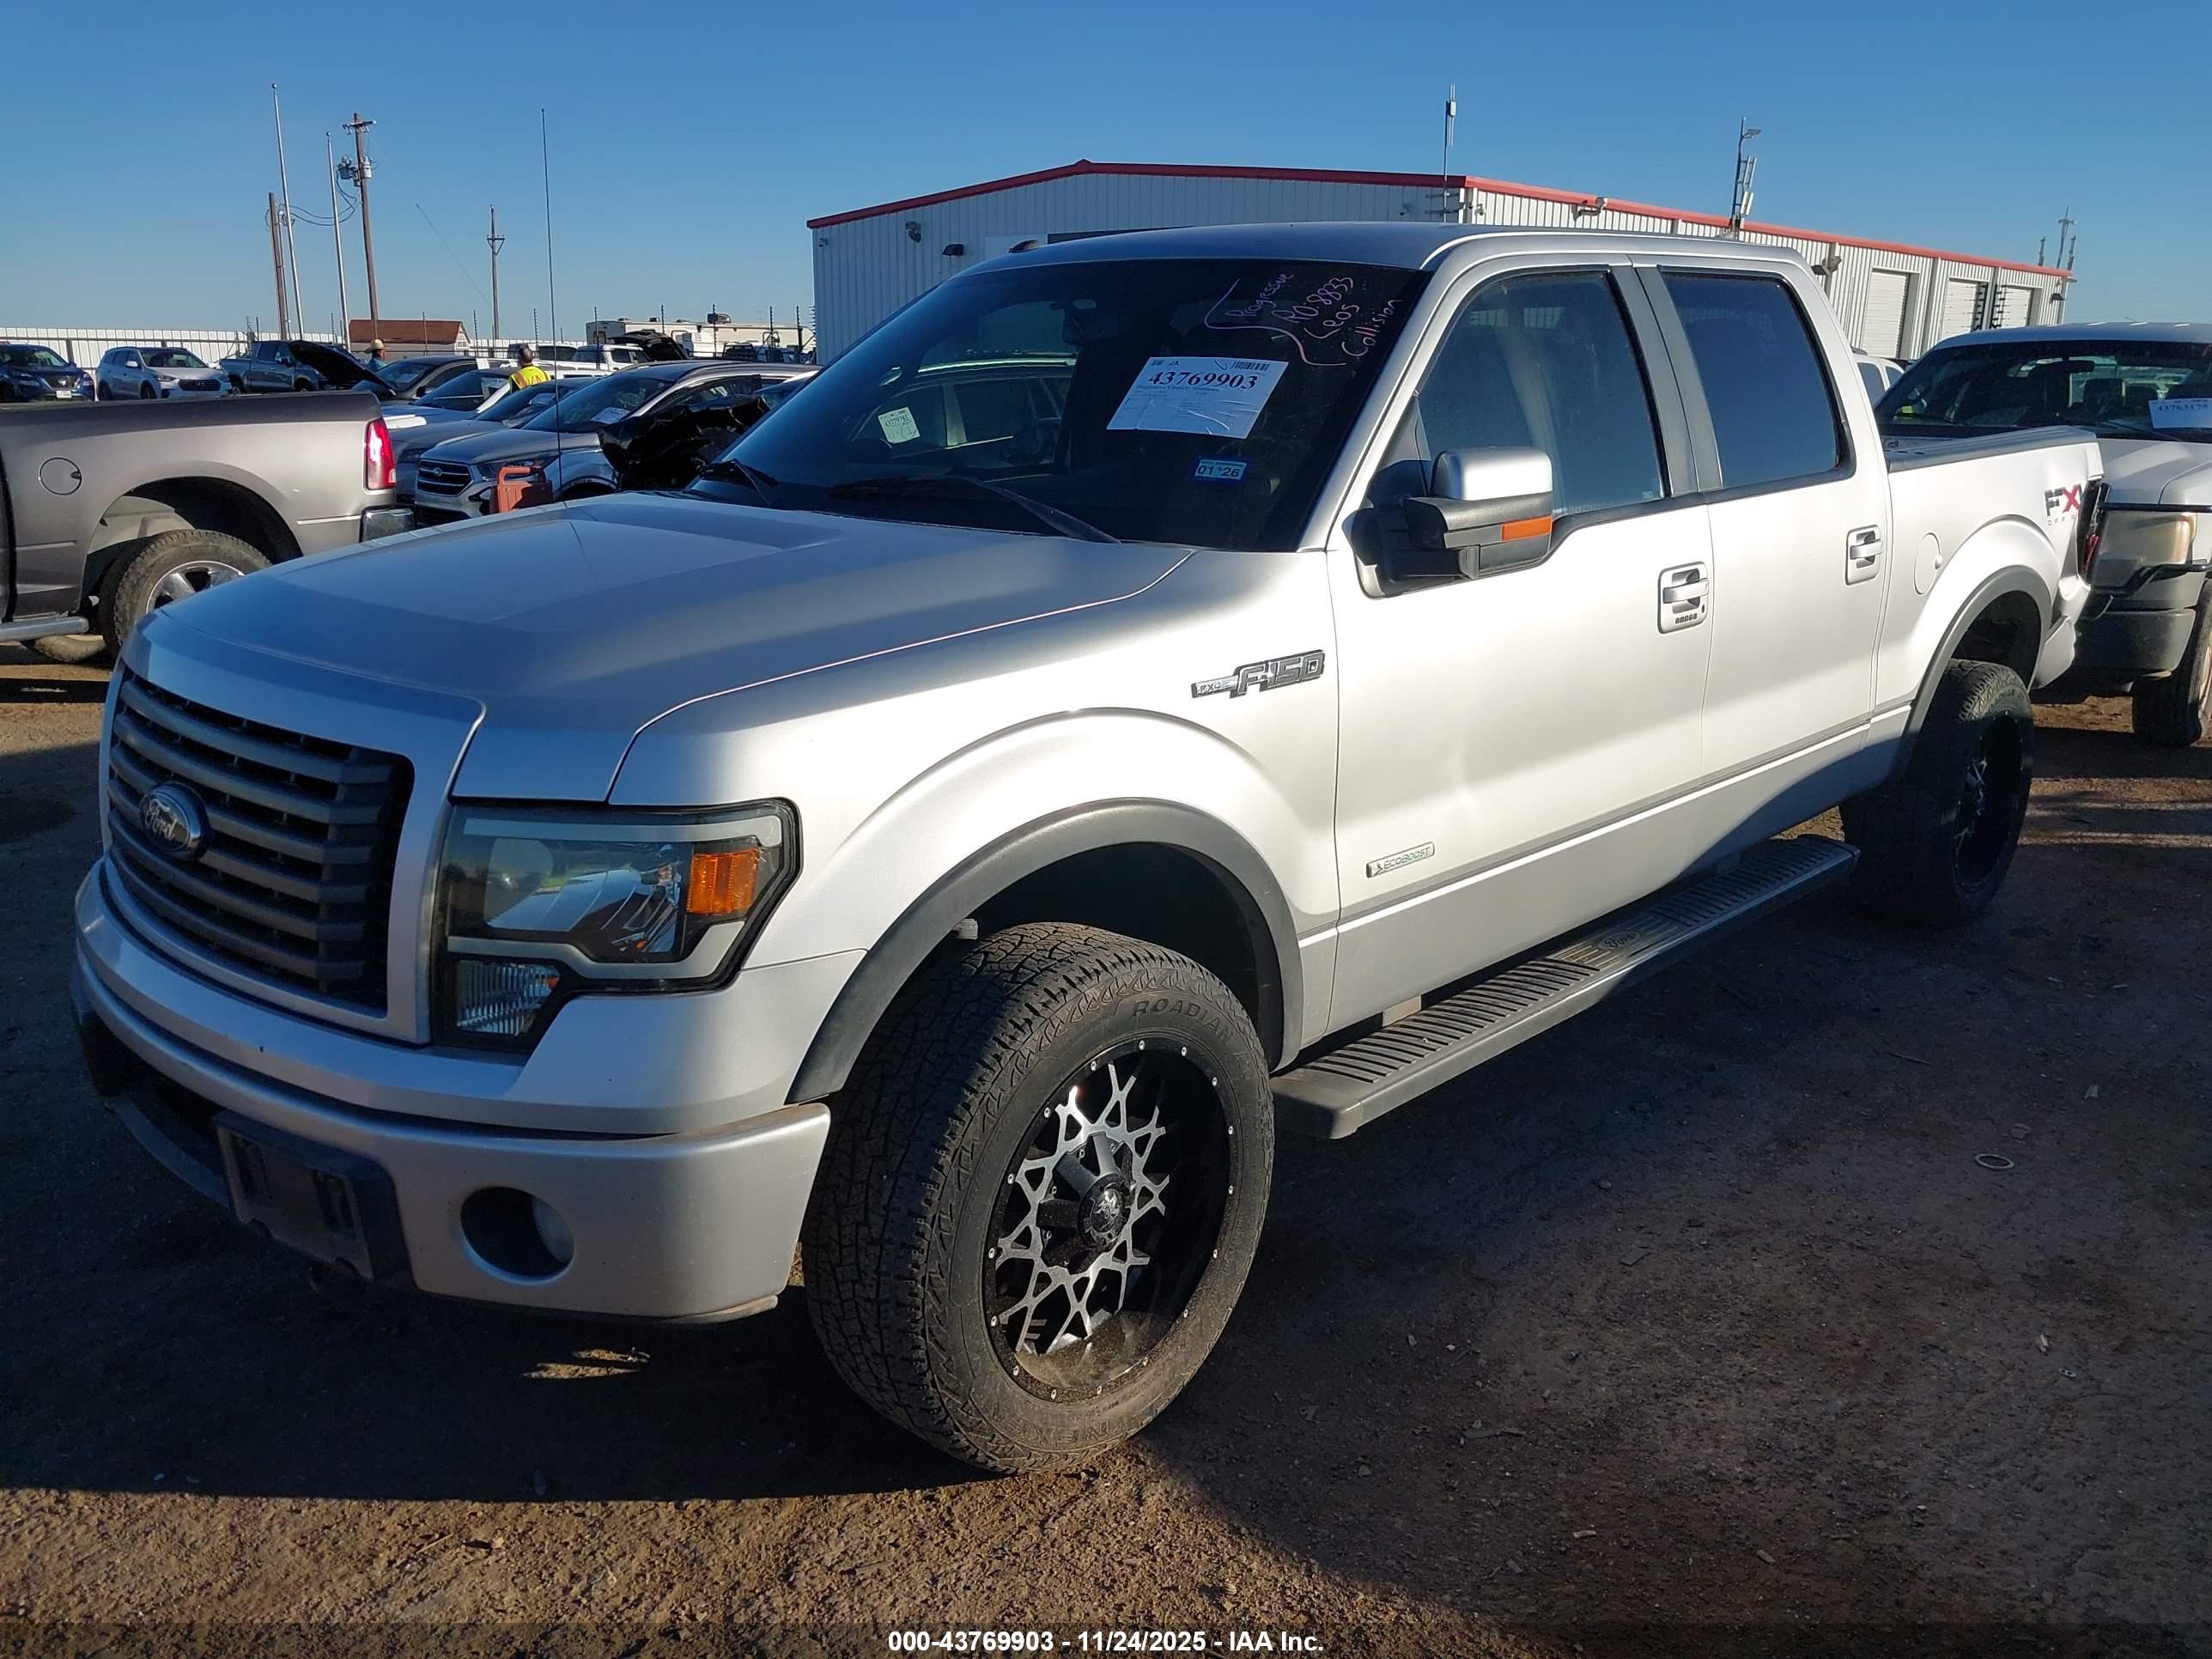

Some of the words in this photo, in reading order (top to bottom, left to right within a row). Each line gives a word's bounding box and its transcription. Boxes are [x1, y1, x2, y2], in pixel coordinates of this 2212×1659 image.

[1149, 371, 1258, 390] 43769903
[1198, 465, 1215, 476] 01
[1221, 466, 1241, 477] 26
[2045, 483, 2082, 518] FX
[1132, 998, 1235, 1045] ROADIAN
